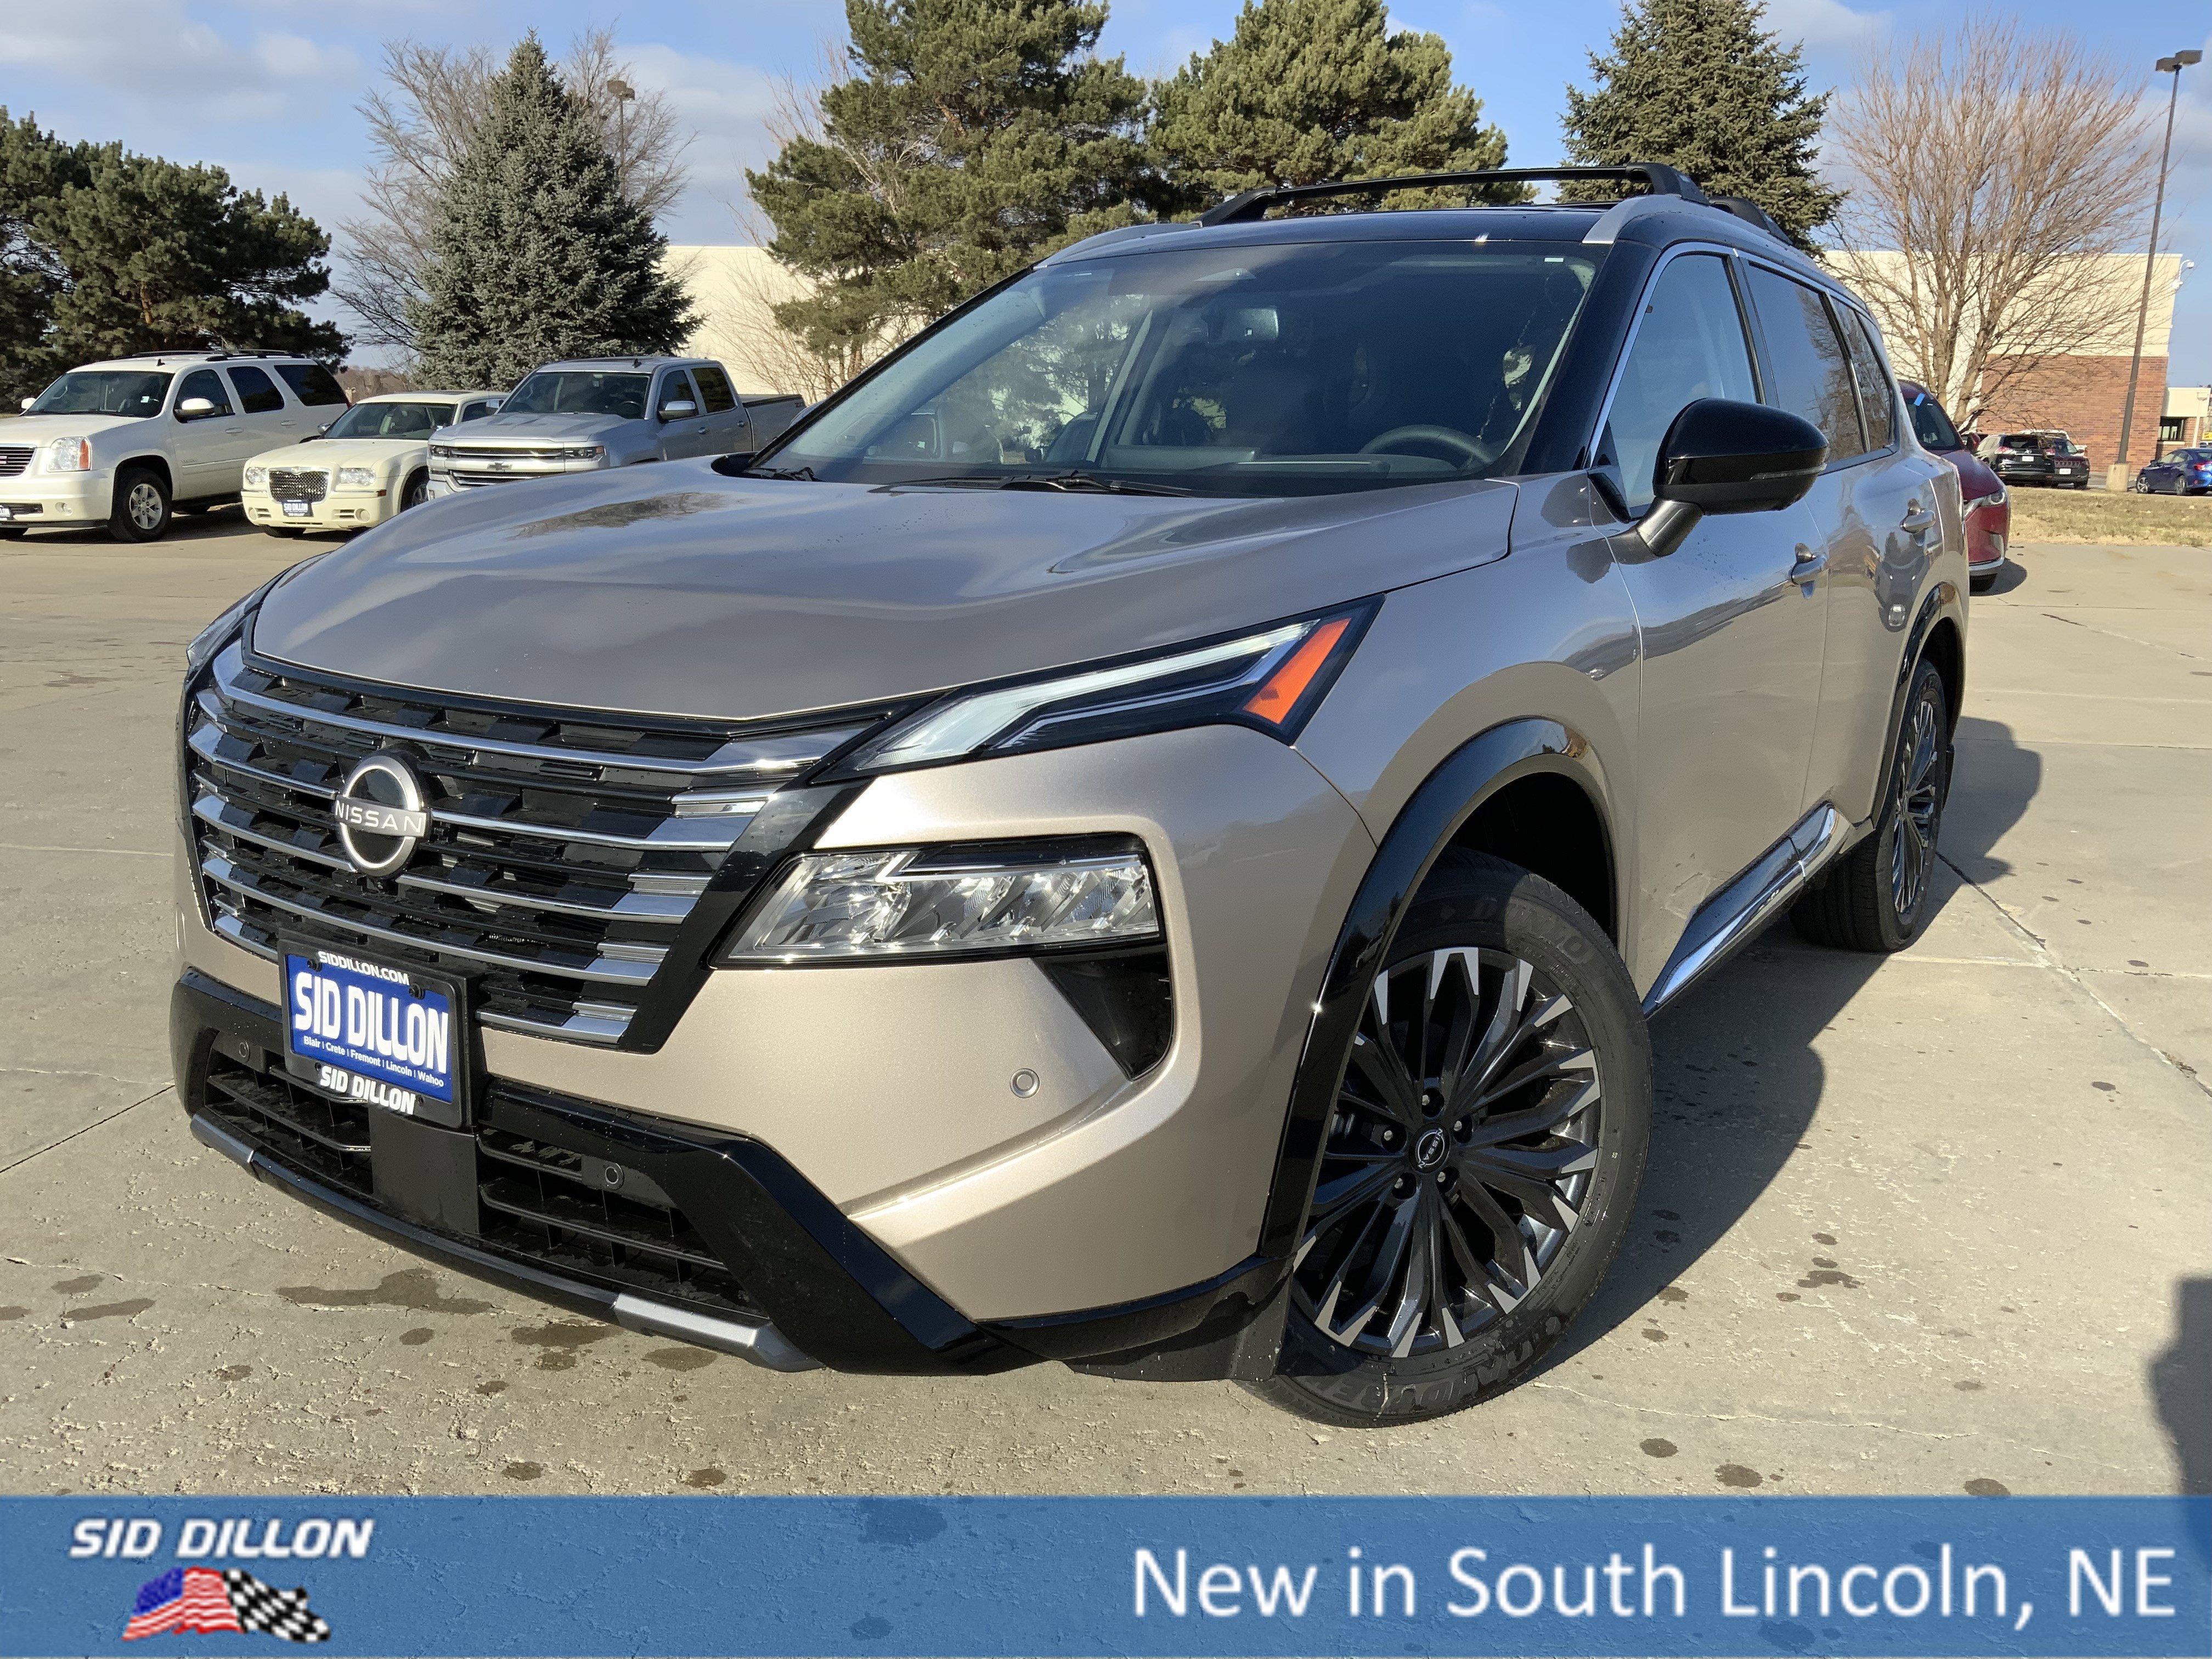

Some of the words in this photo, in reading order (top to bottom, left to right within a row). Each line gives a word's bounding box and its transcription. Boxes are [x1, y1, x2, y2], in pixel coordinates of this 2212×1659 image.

[335, 799, 422, 833] NISSAN
[318, 951, 410, 986] SIDDILLON.COM
[295, 972, 341, 1040] SID
[347, 985, 449, 1074] DILLON
[304, 1036, 321, 1048] Blair
[326, 1042, 346, 1056] Crete
[351, 1049, 381, 1067] Fremont
[386, 1060, 413, 1077] Lincoln
[417, 1070, 444, 1087] Wahoo
[320, 1065, 349, 1093] SID
[352, 1075, 416, 1115] DILLON
[1418, 1128, 1443, 1169] NISSAN
